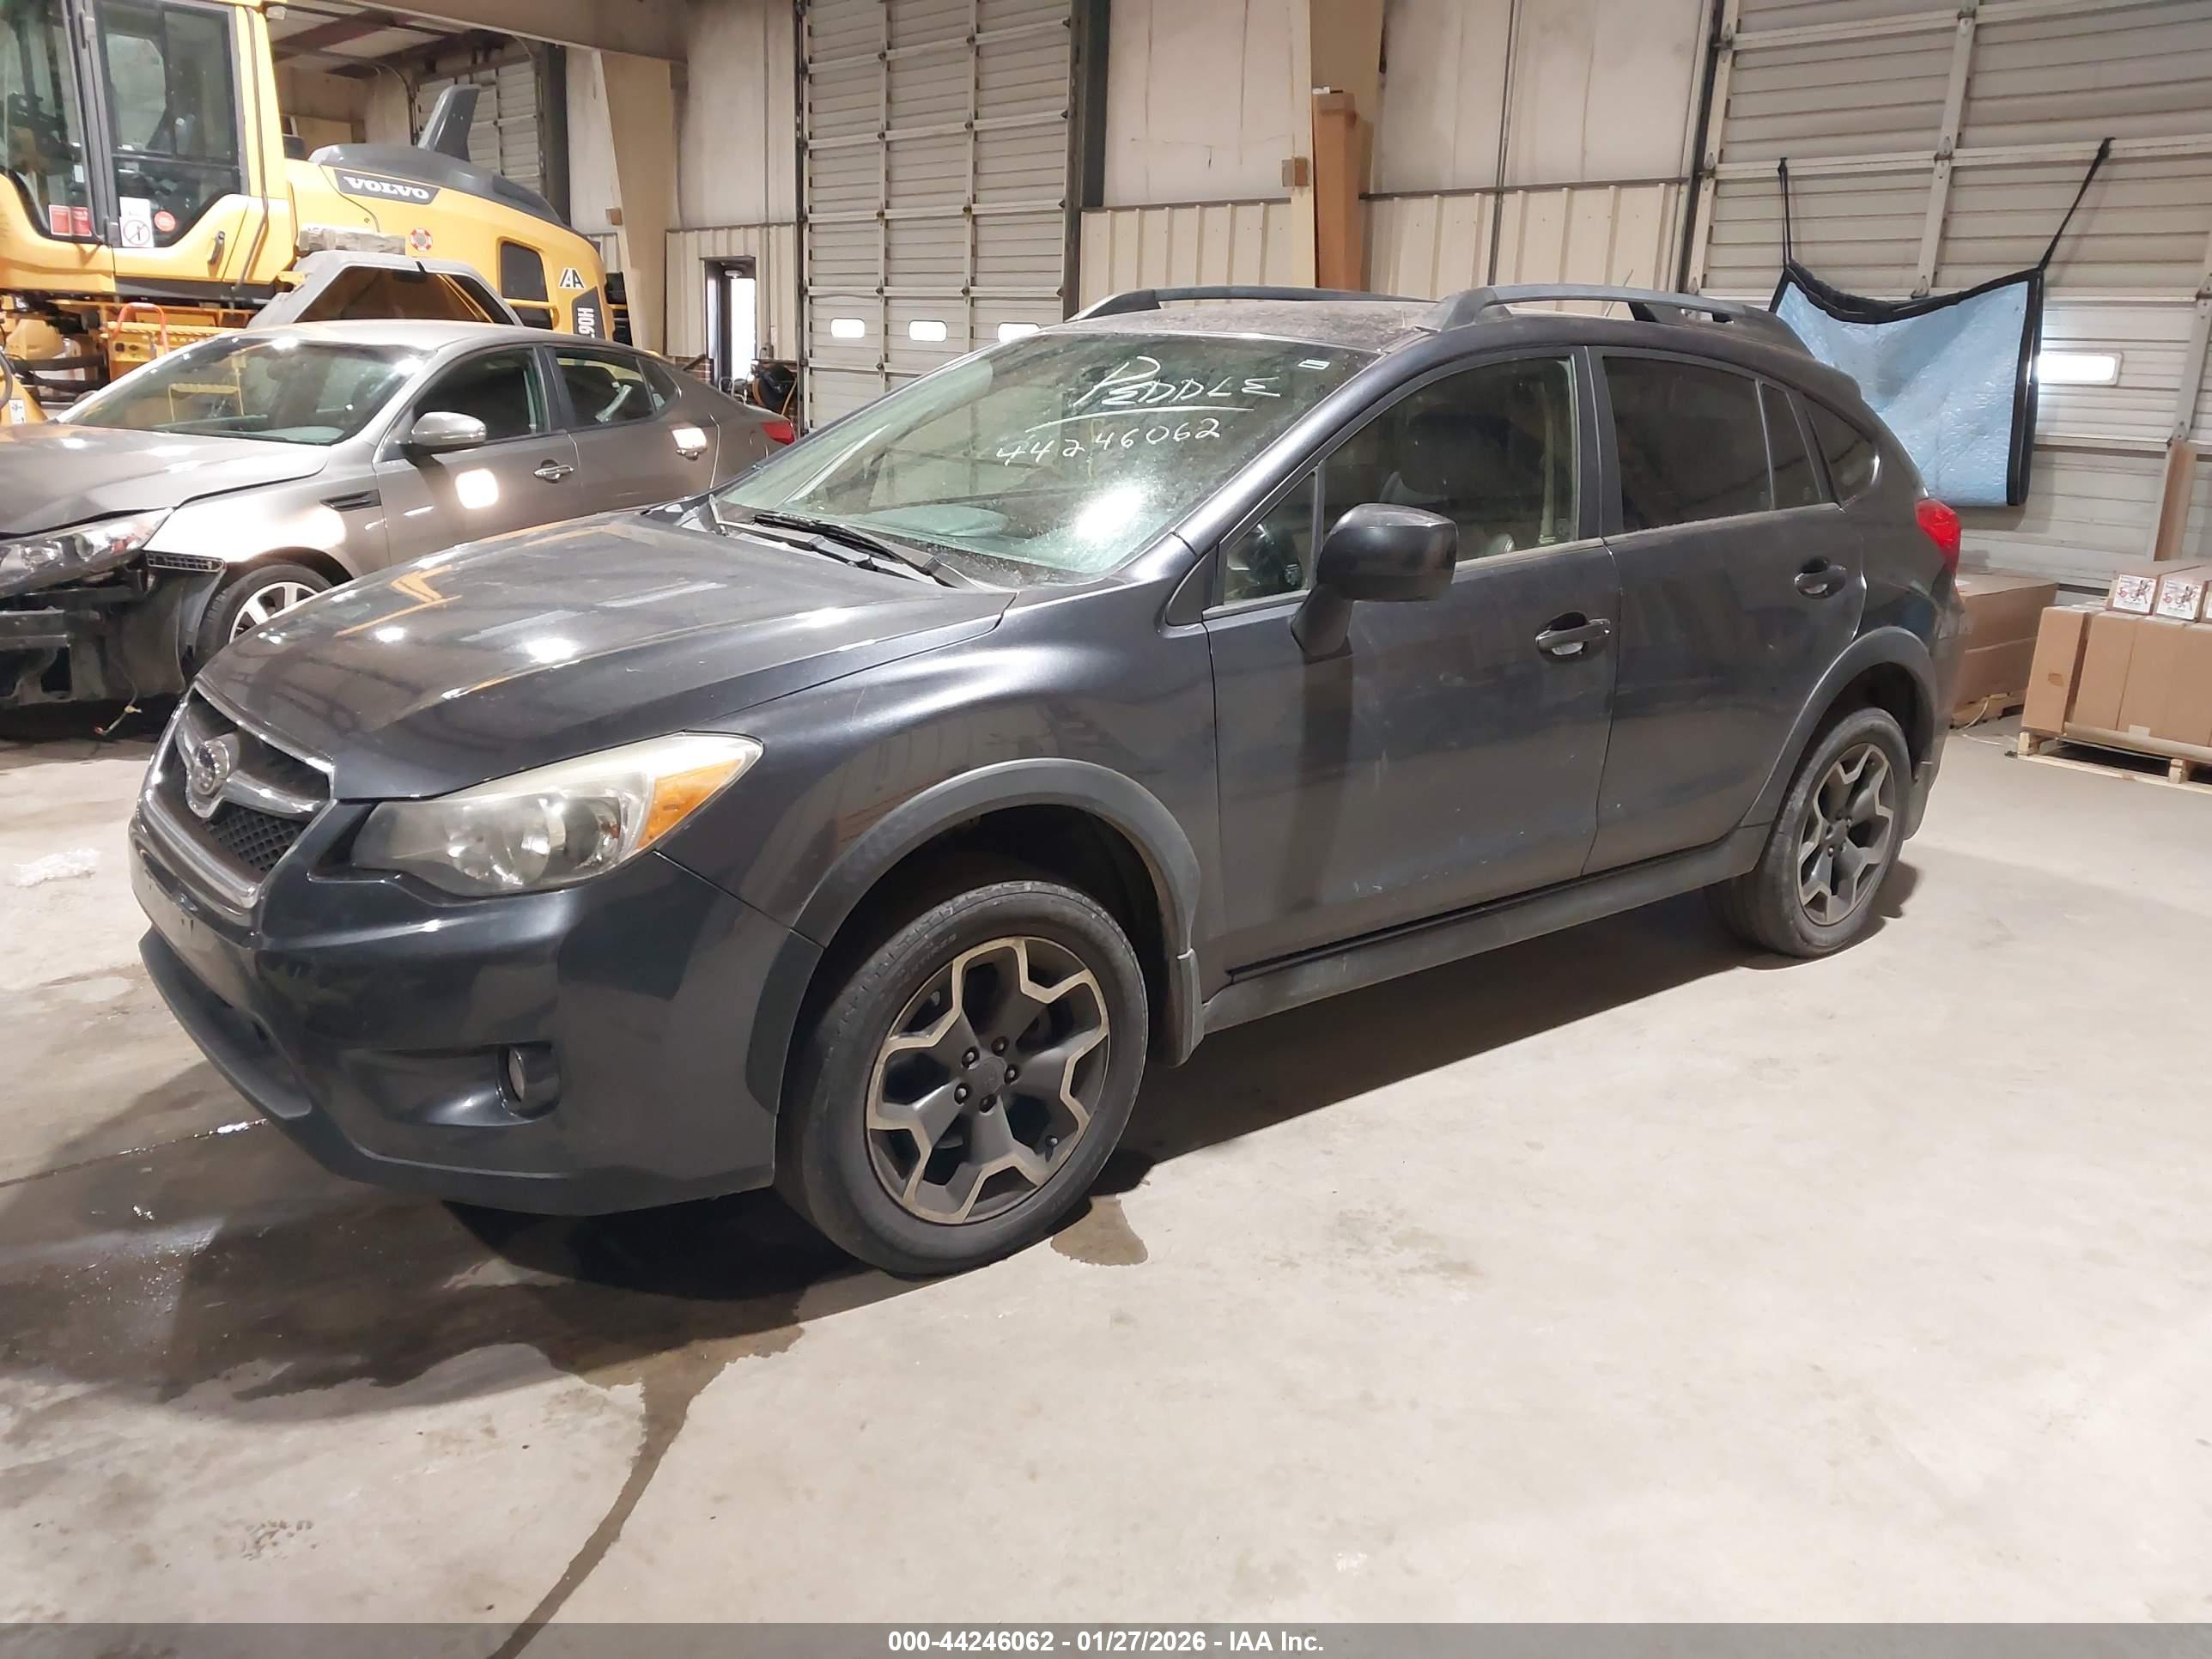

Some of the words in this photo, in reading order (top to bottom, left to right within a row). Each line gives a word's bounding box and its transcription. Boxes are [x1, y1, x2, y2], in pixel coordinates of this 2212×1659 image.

[343, 176, 429, 200] VOLVO
[576, 307, 596, 338] 90H
[1072, 356, 1281, 408] PEDDLE
[995, 417, 1221, 466] 44246062
